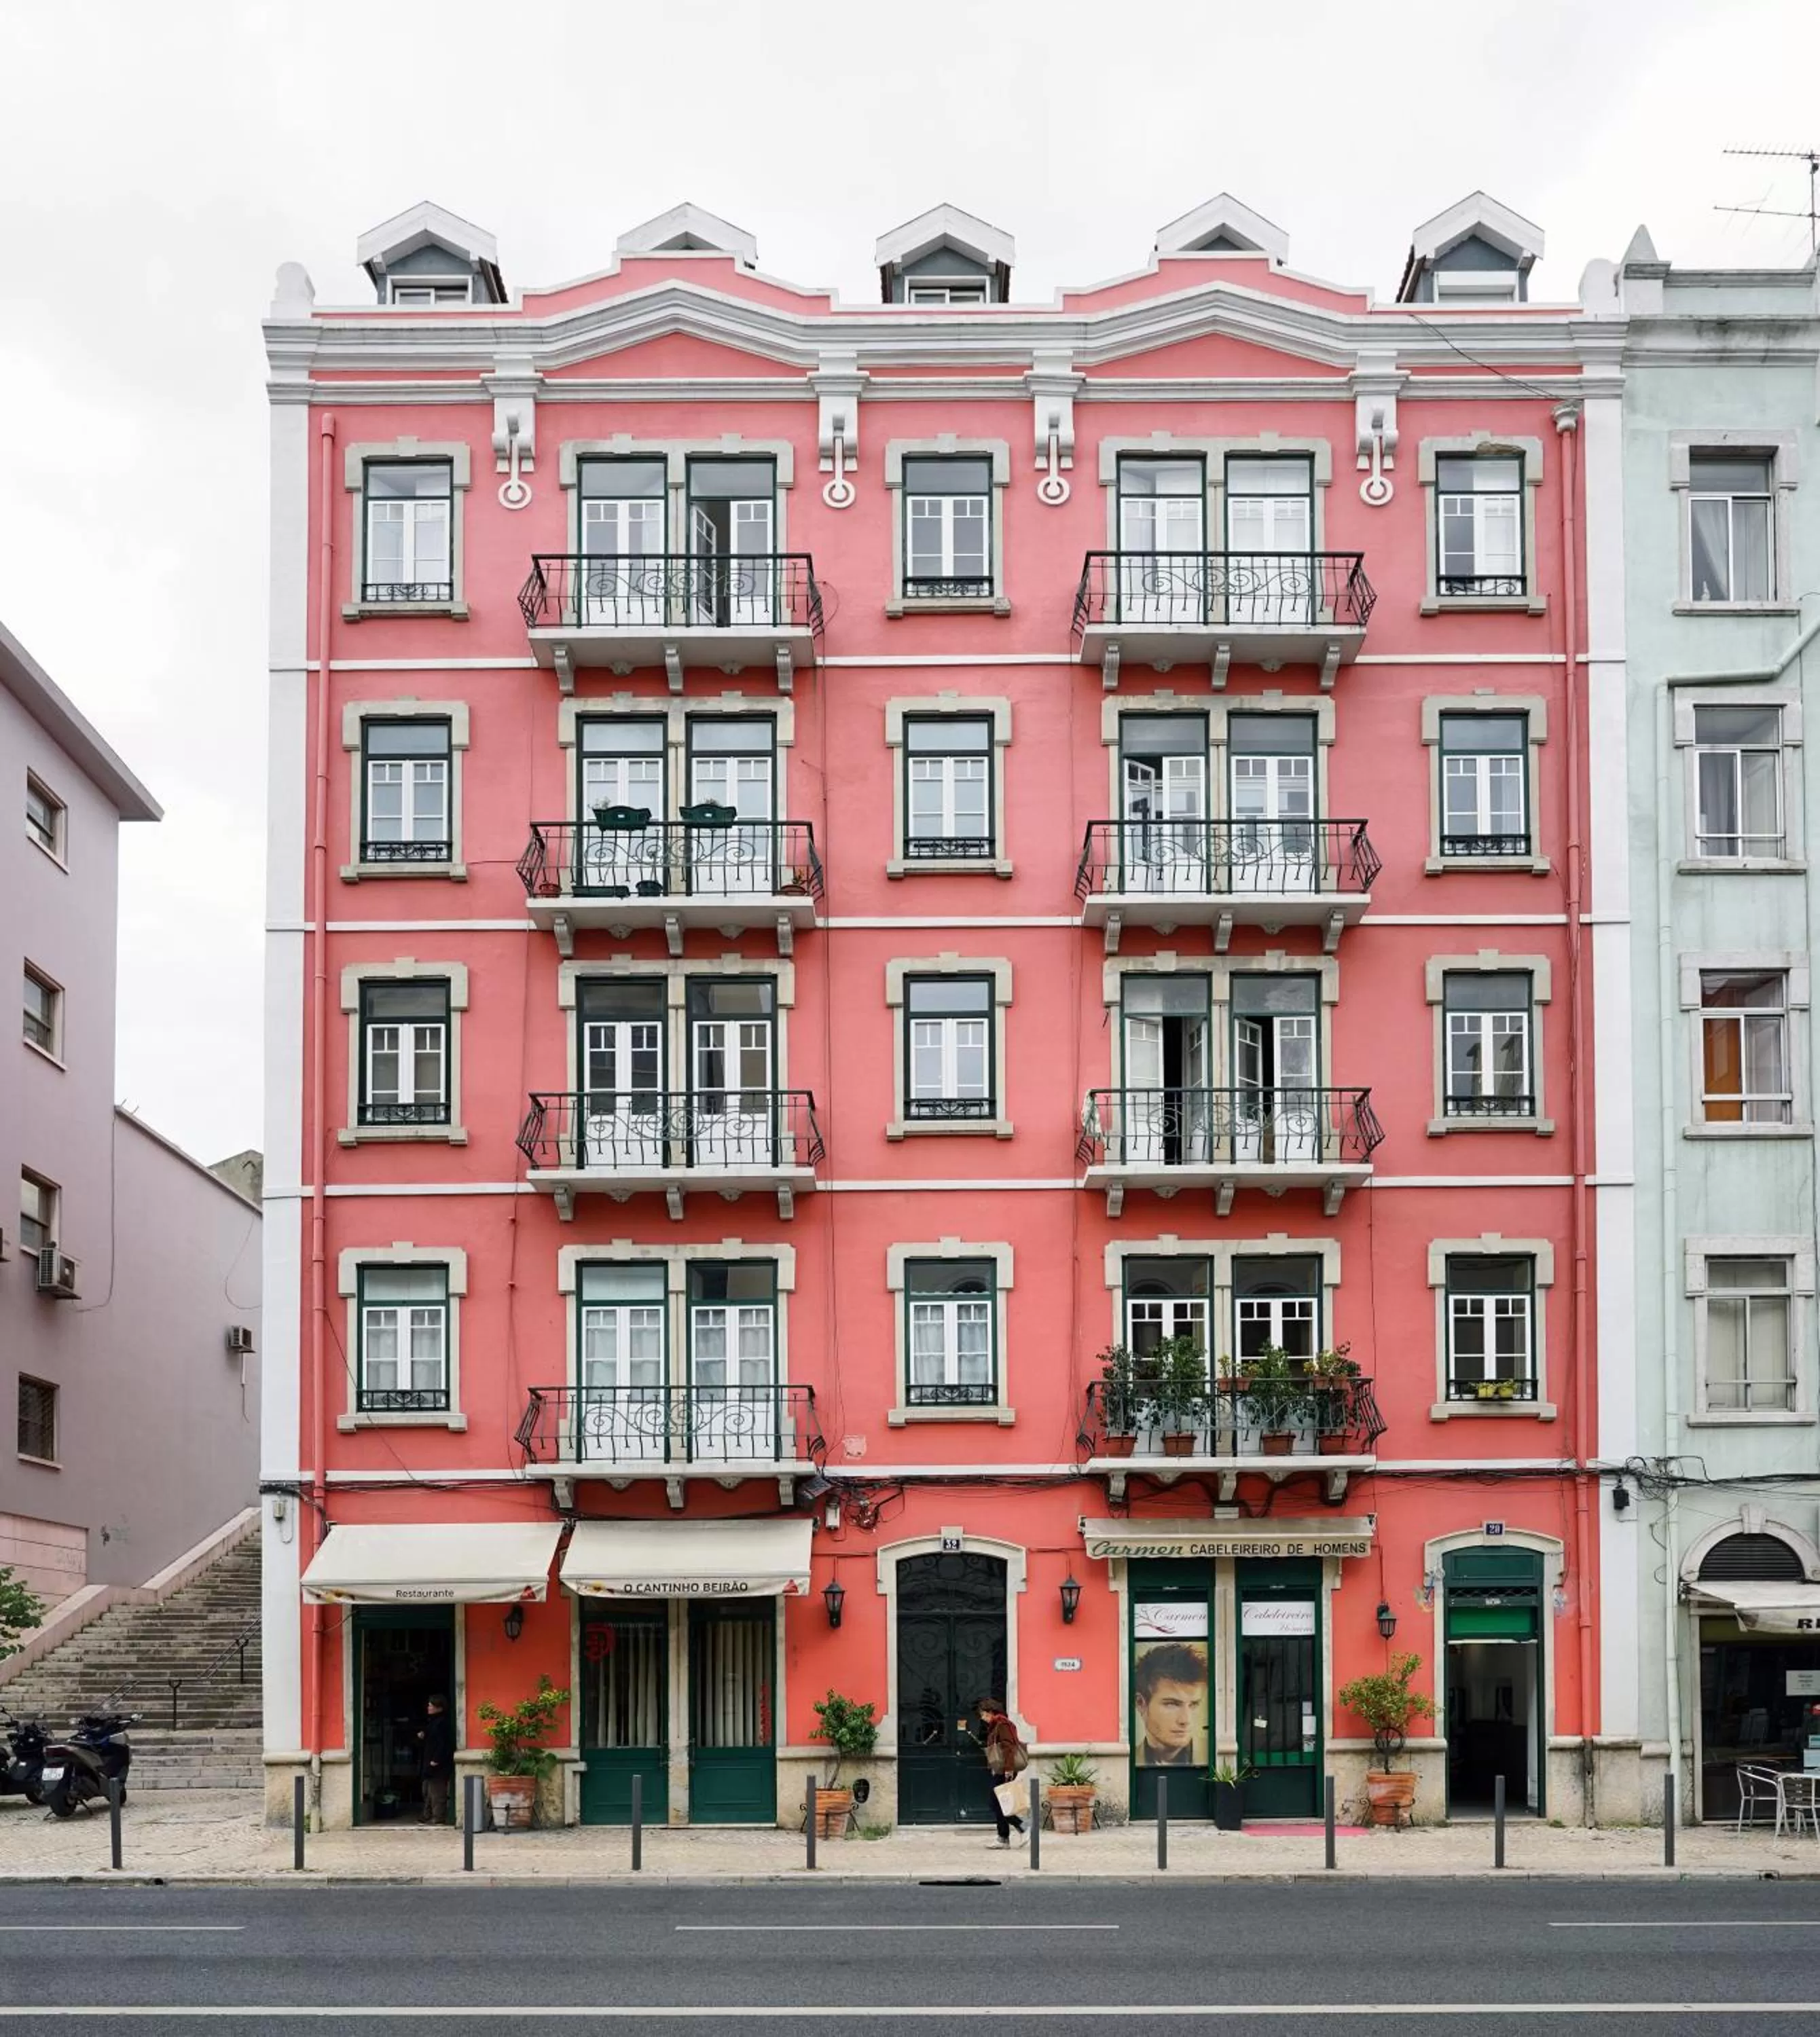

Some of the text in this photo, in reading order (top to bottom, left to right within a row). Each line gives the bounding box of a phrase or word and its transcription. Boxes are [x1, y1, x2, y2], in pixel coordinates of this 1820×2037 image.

[946, 1539, 957, 1549] 32
[1092, 1541, 1366, 1556] Carmen CABELEIREIRO DE HOMENS
[624, 1580, 748, 1593] O CANTINHO BEIRÃO
[396, 1590, 454, 1598] Restaurante
